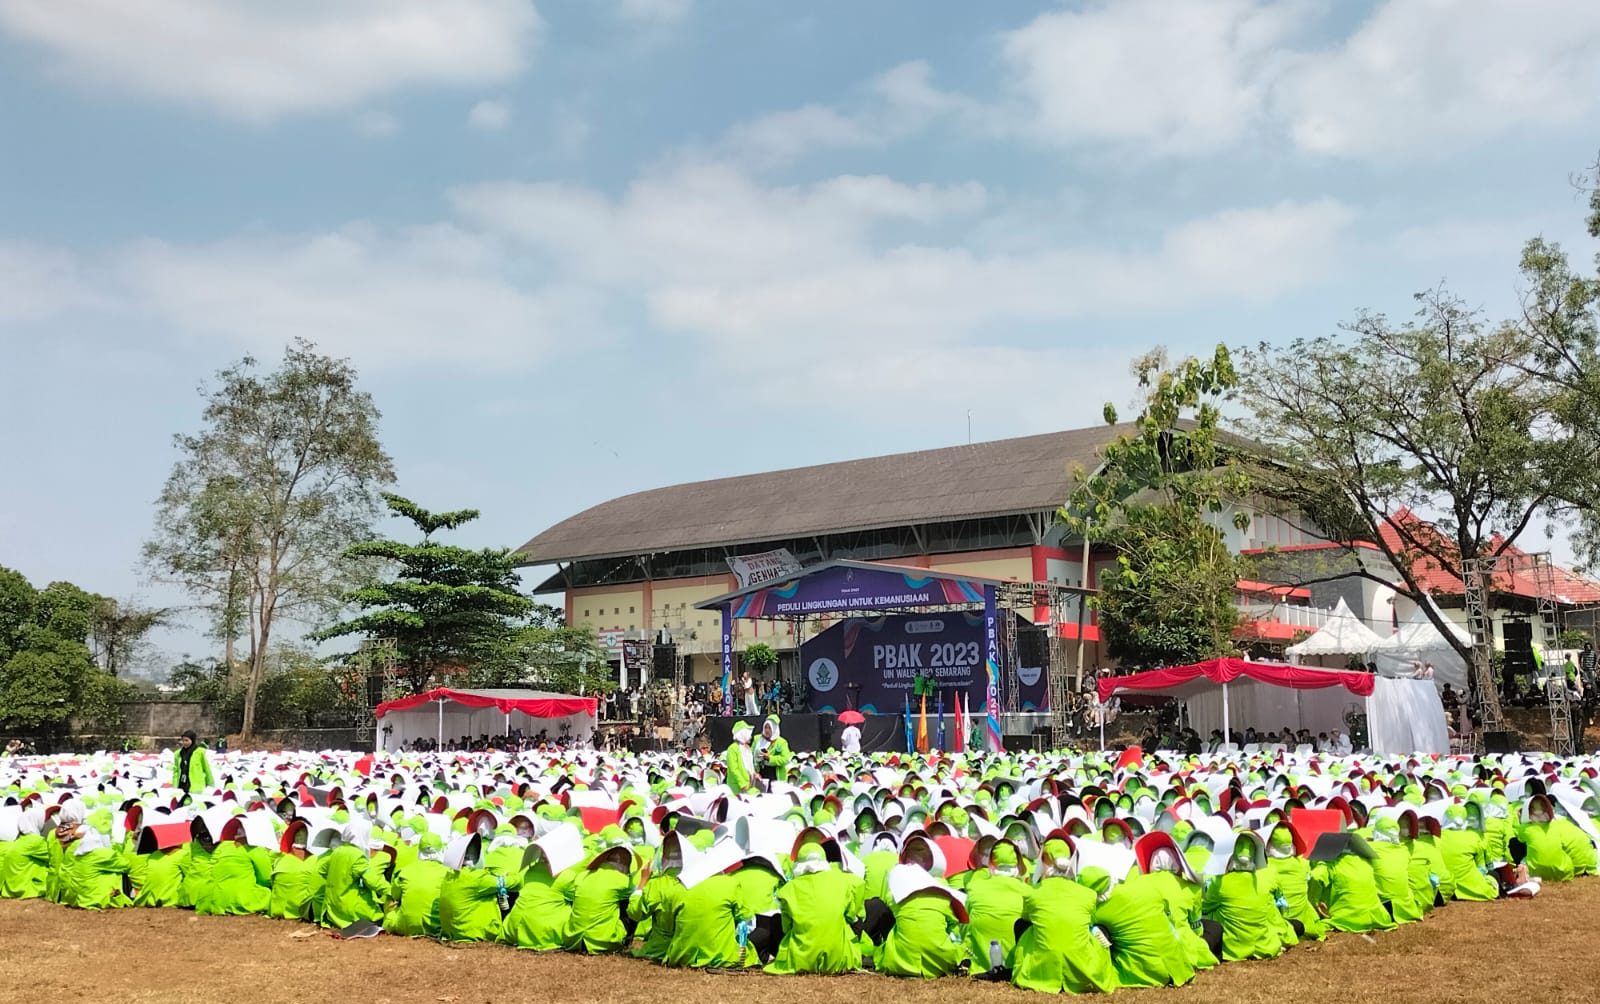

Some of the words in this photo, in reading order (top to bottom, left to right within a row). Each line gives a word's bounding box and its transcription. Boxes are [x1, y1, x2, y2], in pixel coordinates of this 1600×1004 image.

[777, 602, 801, 612] PEDULI
[802, 599, 848, 610] LINGKUNGAN
[849, 597, 873, 607] UNTUK
[875, 593, 929, 605] KEMANUSIAAN
[987, 617, 996, 661] PBAK
[873, 644, 922, 669] PBAK
[930, 642, 980, 667] 2023
[883, 669, 895, 679] UIN
[896, 667, 933, 678] WALISNGO
[935, 666, 971, 677] SEMARANG
